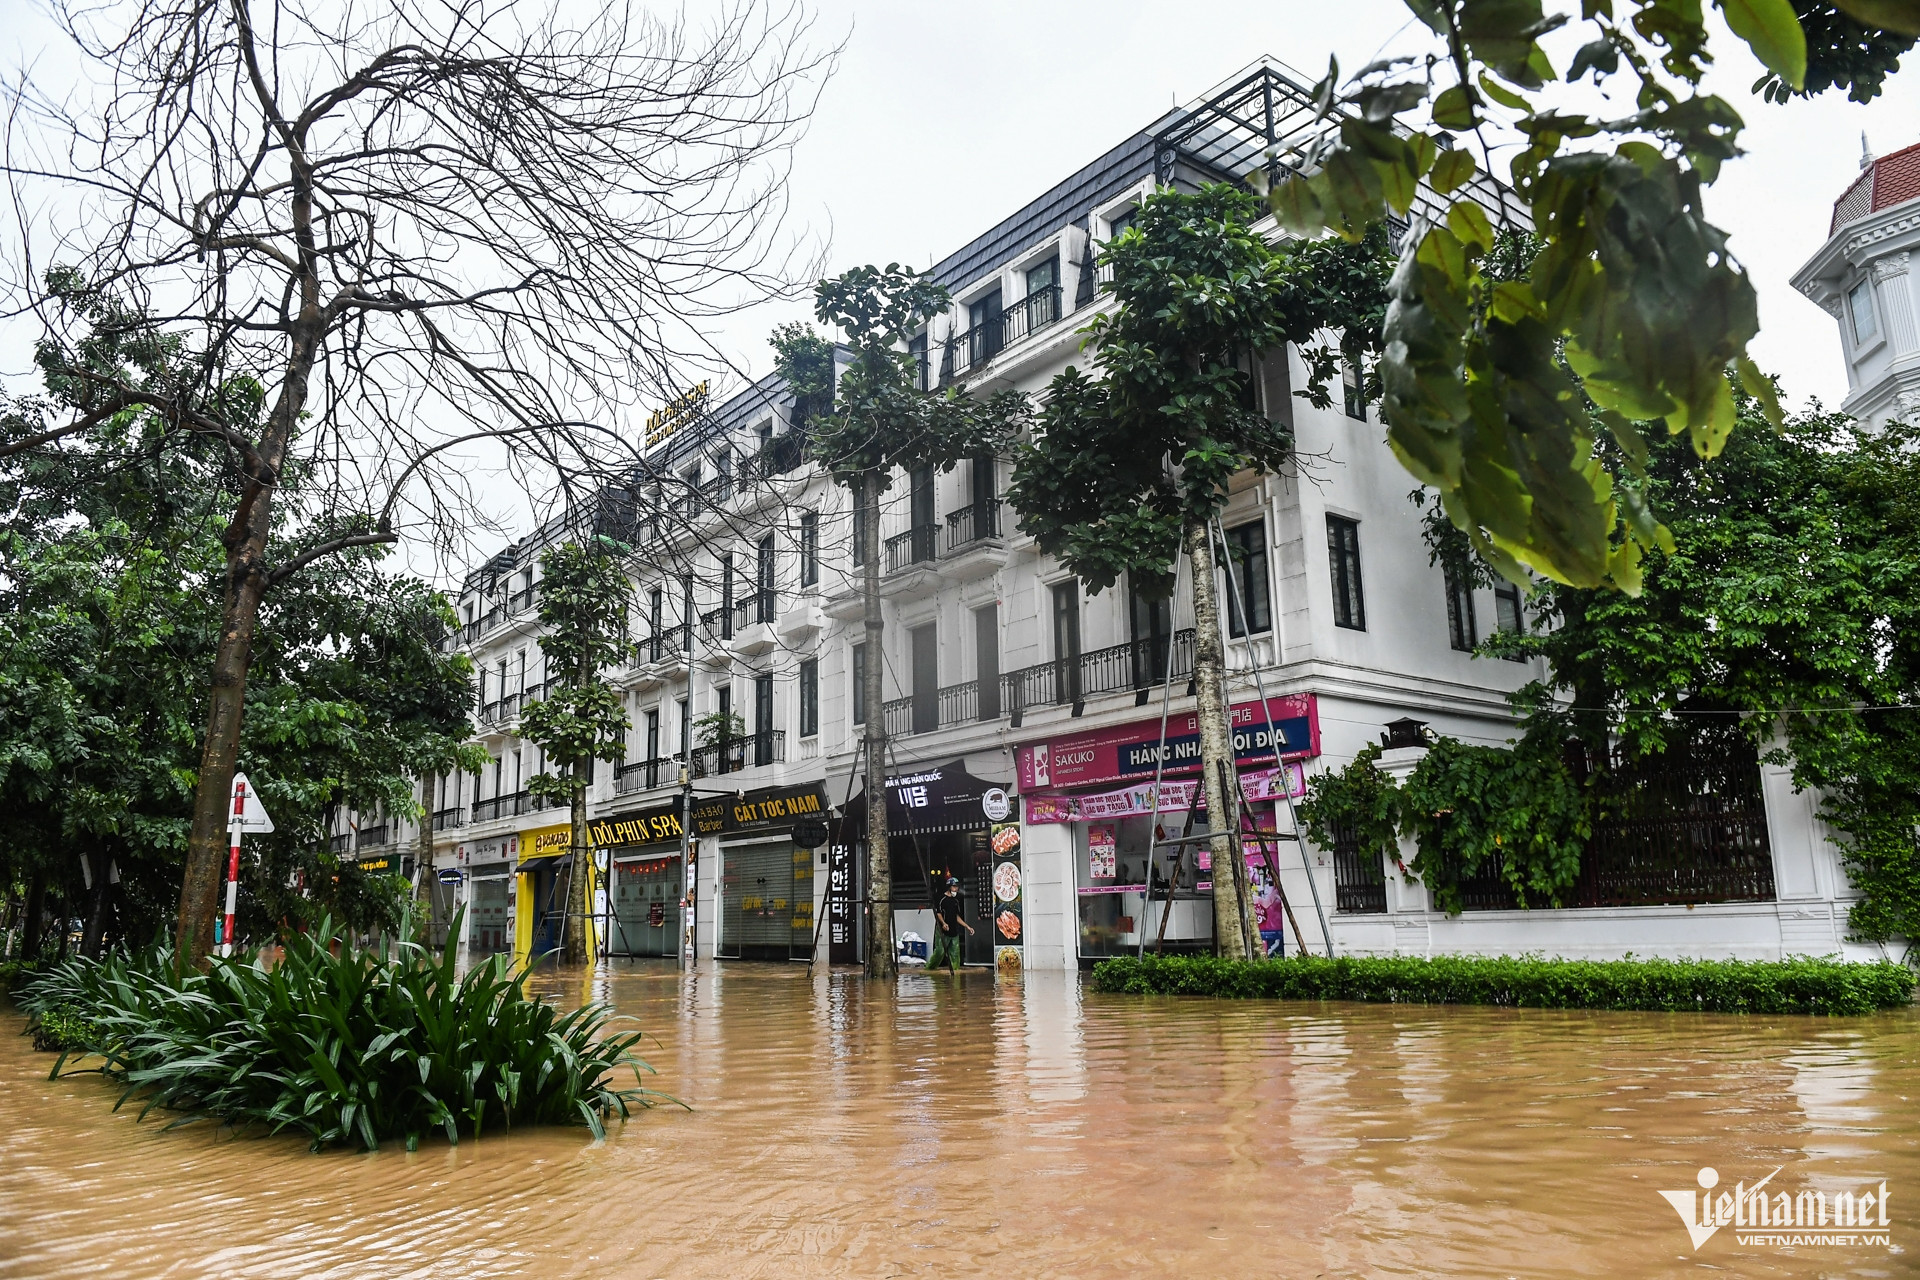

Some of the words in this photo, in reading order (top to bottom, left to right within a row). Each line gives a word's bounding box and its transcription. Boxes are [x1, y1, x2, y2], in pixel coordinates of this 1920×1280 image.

[1130, 743, 1171, 765] HÀNG
[1233, 730, 1251, 756] ỘI
[1255, 728, 1287, 752] ĐỊA
[1055, 750, 1095, 767] SAKUKO
[885, 776, 895, 788] HÀ
[924, 769, 943, 782] QUỐC
[759, 795, 786, 819] TÓC
[785, 794, 820, 815] NAM
[1124, 792, 1133, 809] 1
[593, 819, 650, 845] DÔLPHIN
[650, 813, 683, 838] SPA
[698, 820, 723, 832] Barber
